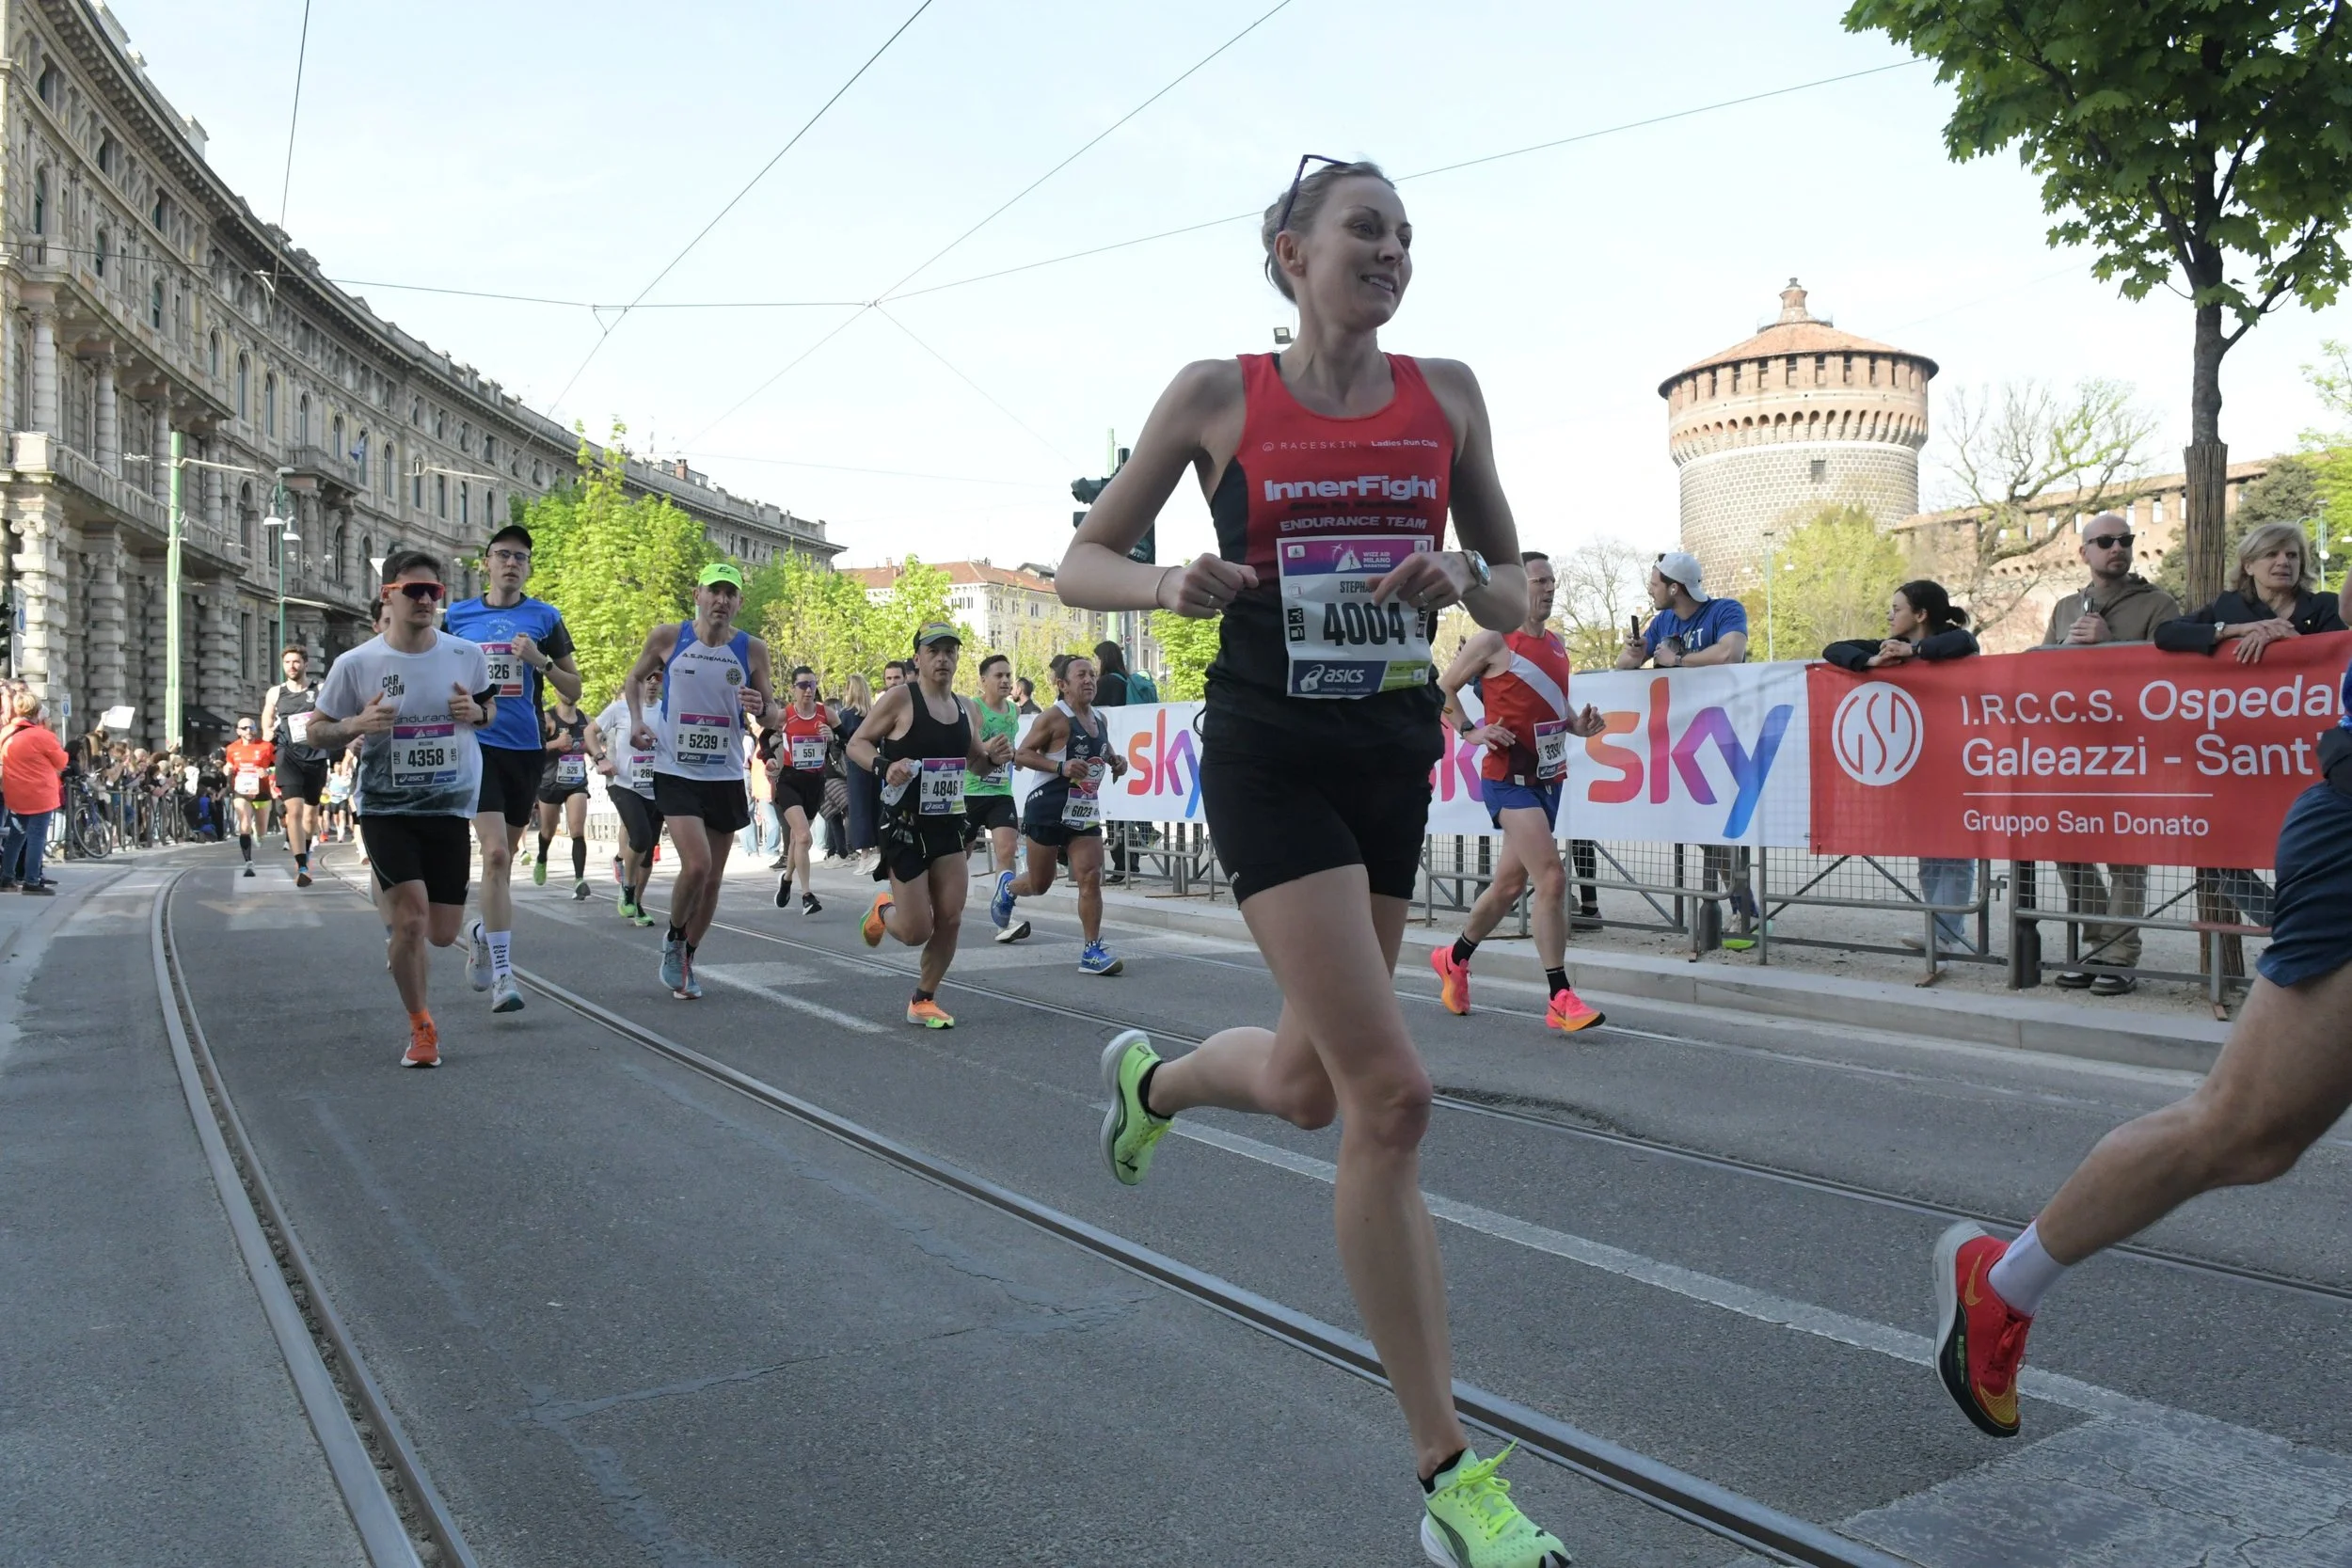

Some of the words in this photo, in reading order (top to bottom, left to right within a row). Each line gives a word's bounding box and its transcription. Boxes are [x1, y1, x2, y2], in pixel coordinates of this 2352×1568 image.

[1280, 440, 1358, 450] RACESKIN
[1422, 439, 1438, 448] Club
[1264, 475, 1436, 501] InnerFight
[1279, 516, 1379, 531] ENDURANCE
[1386, 516, 1427, 530] TEAM
[1323, 602, 1406, 646] 4004
[382, 674, 399, 688] CAR
[1324, 669, 1365, 683] asics
[388, 685, 405, 697] SON
[1961, 689, 2123, 725] I.R.C.C.S.
[689, 734, 719, 750] 5239
[407, 749, 444, 767] 4358
[803, 749, 815, 758] 551
[1586, 677, 1794, 838] sky
[1963, 736, 2146, 777] Galeazzi
[1127, 708, 1201, 818] sky
[932, 780, 958, 797] 4846
[1072, 805, 1092, 817] 6023
[1963, 810, 2049, 836] Gruppo
[2058, 811, 2104, 833] San
[2114, 812, 2208, 836] Donato
